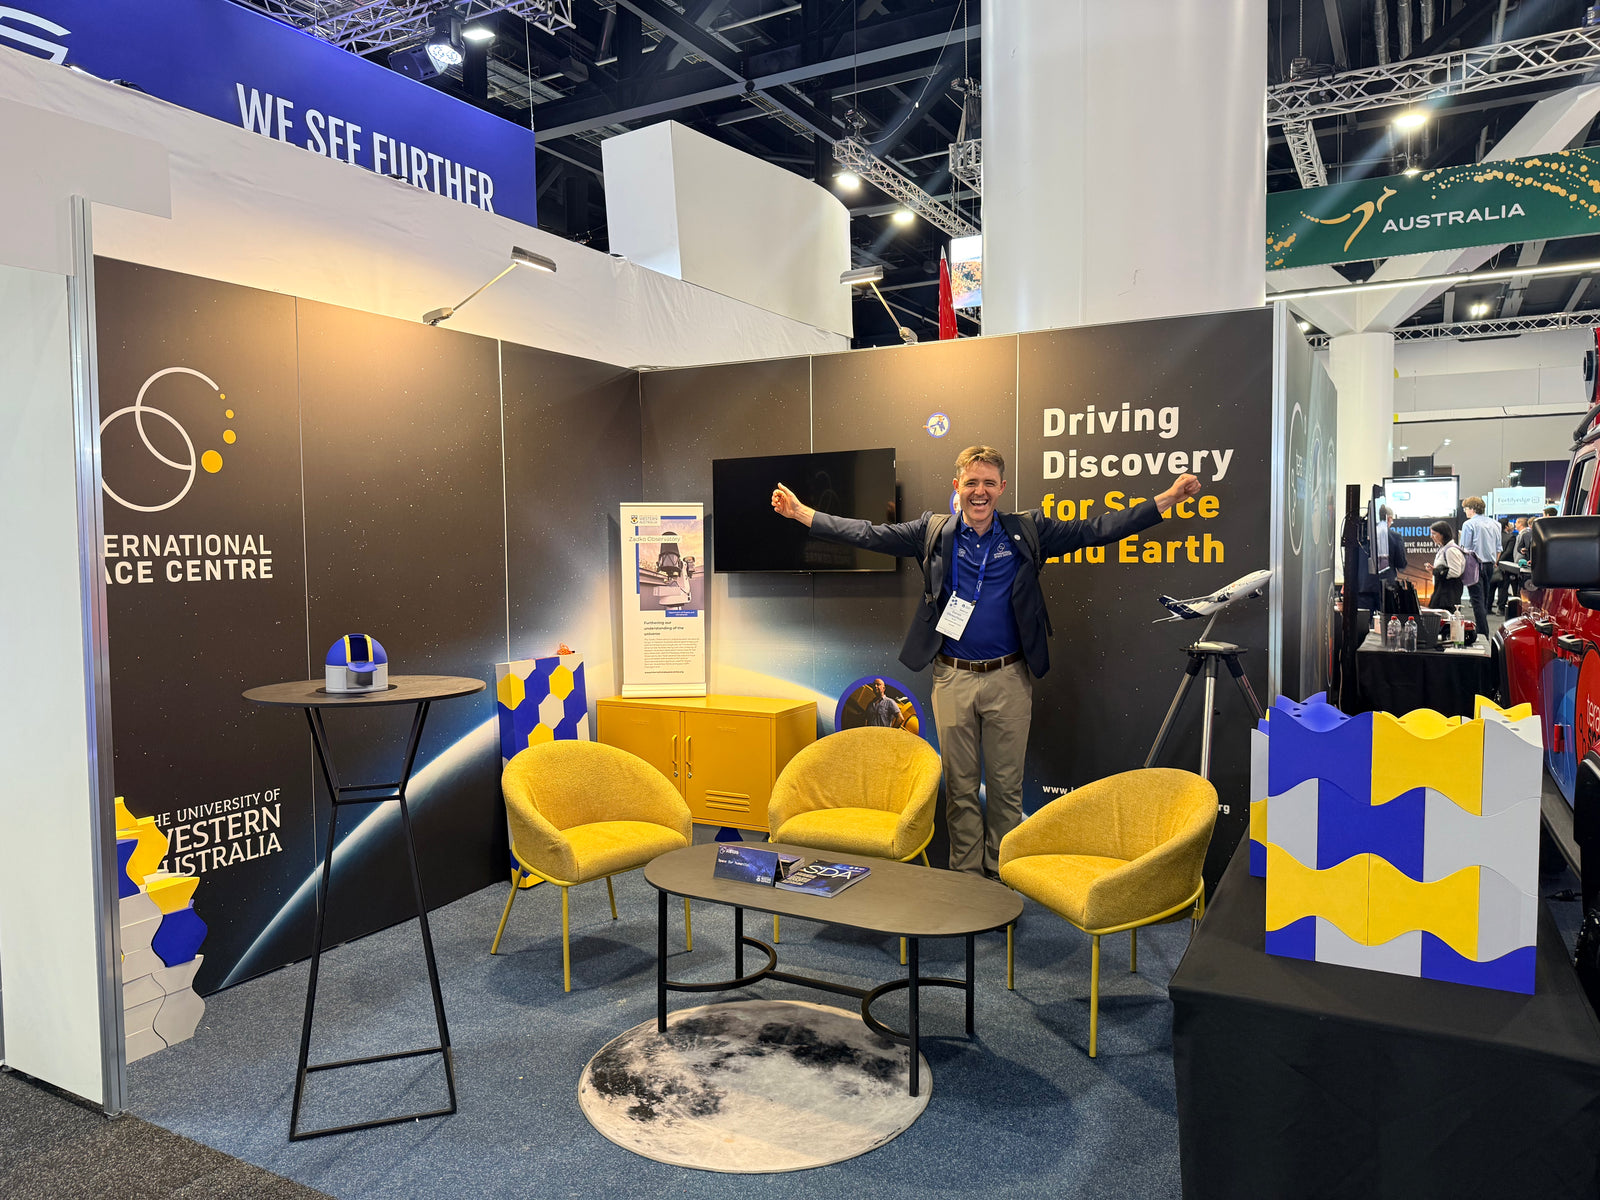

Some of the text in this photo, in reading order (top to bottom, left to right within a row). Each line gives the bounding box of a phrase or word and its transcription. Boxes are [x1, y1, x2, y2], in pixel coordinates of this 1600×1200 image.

[236, 83, 494, 213] WE SEE FURTHER
[1382, 203, 1526, 233] AUSTRALIA
[1043, 402, 1180, 439] Driving
[1043, 449, 1234, 482] Discovery
[1041, 491, 1220, 522] for Sce
[103, 534, 272, 558] ERNATIONAL
[1118, 533, 1225, 564] Earth
[165, 558, 274, 583] CENTRE
[176, 792, 261, 822] UNIVERSITY
[264, 788, 280, 802] OF
[803, 865, 852, 880] SDA
